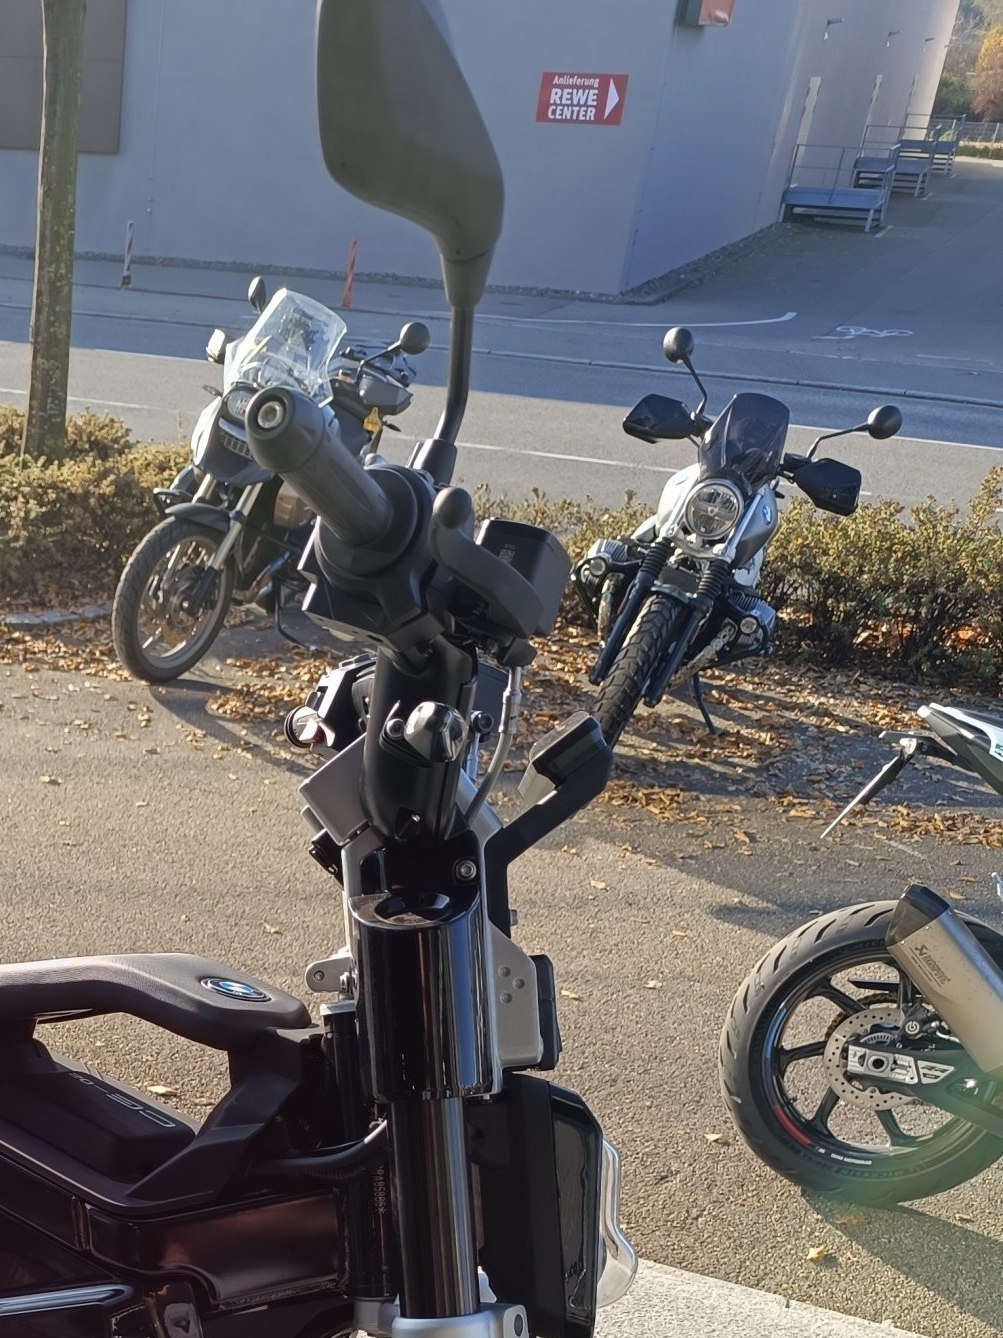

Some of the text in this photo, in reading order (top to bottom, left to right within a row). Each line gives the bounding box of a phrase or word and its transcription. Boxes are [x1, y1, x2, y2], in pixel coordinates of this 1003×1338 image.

[553, 75, 600, 88] Anlieferung
[549, 88, 598, 106] REWE
[547, 106, 596, 121] CENTER
